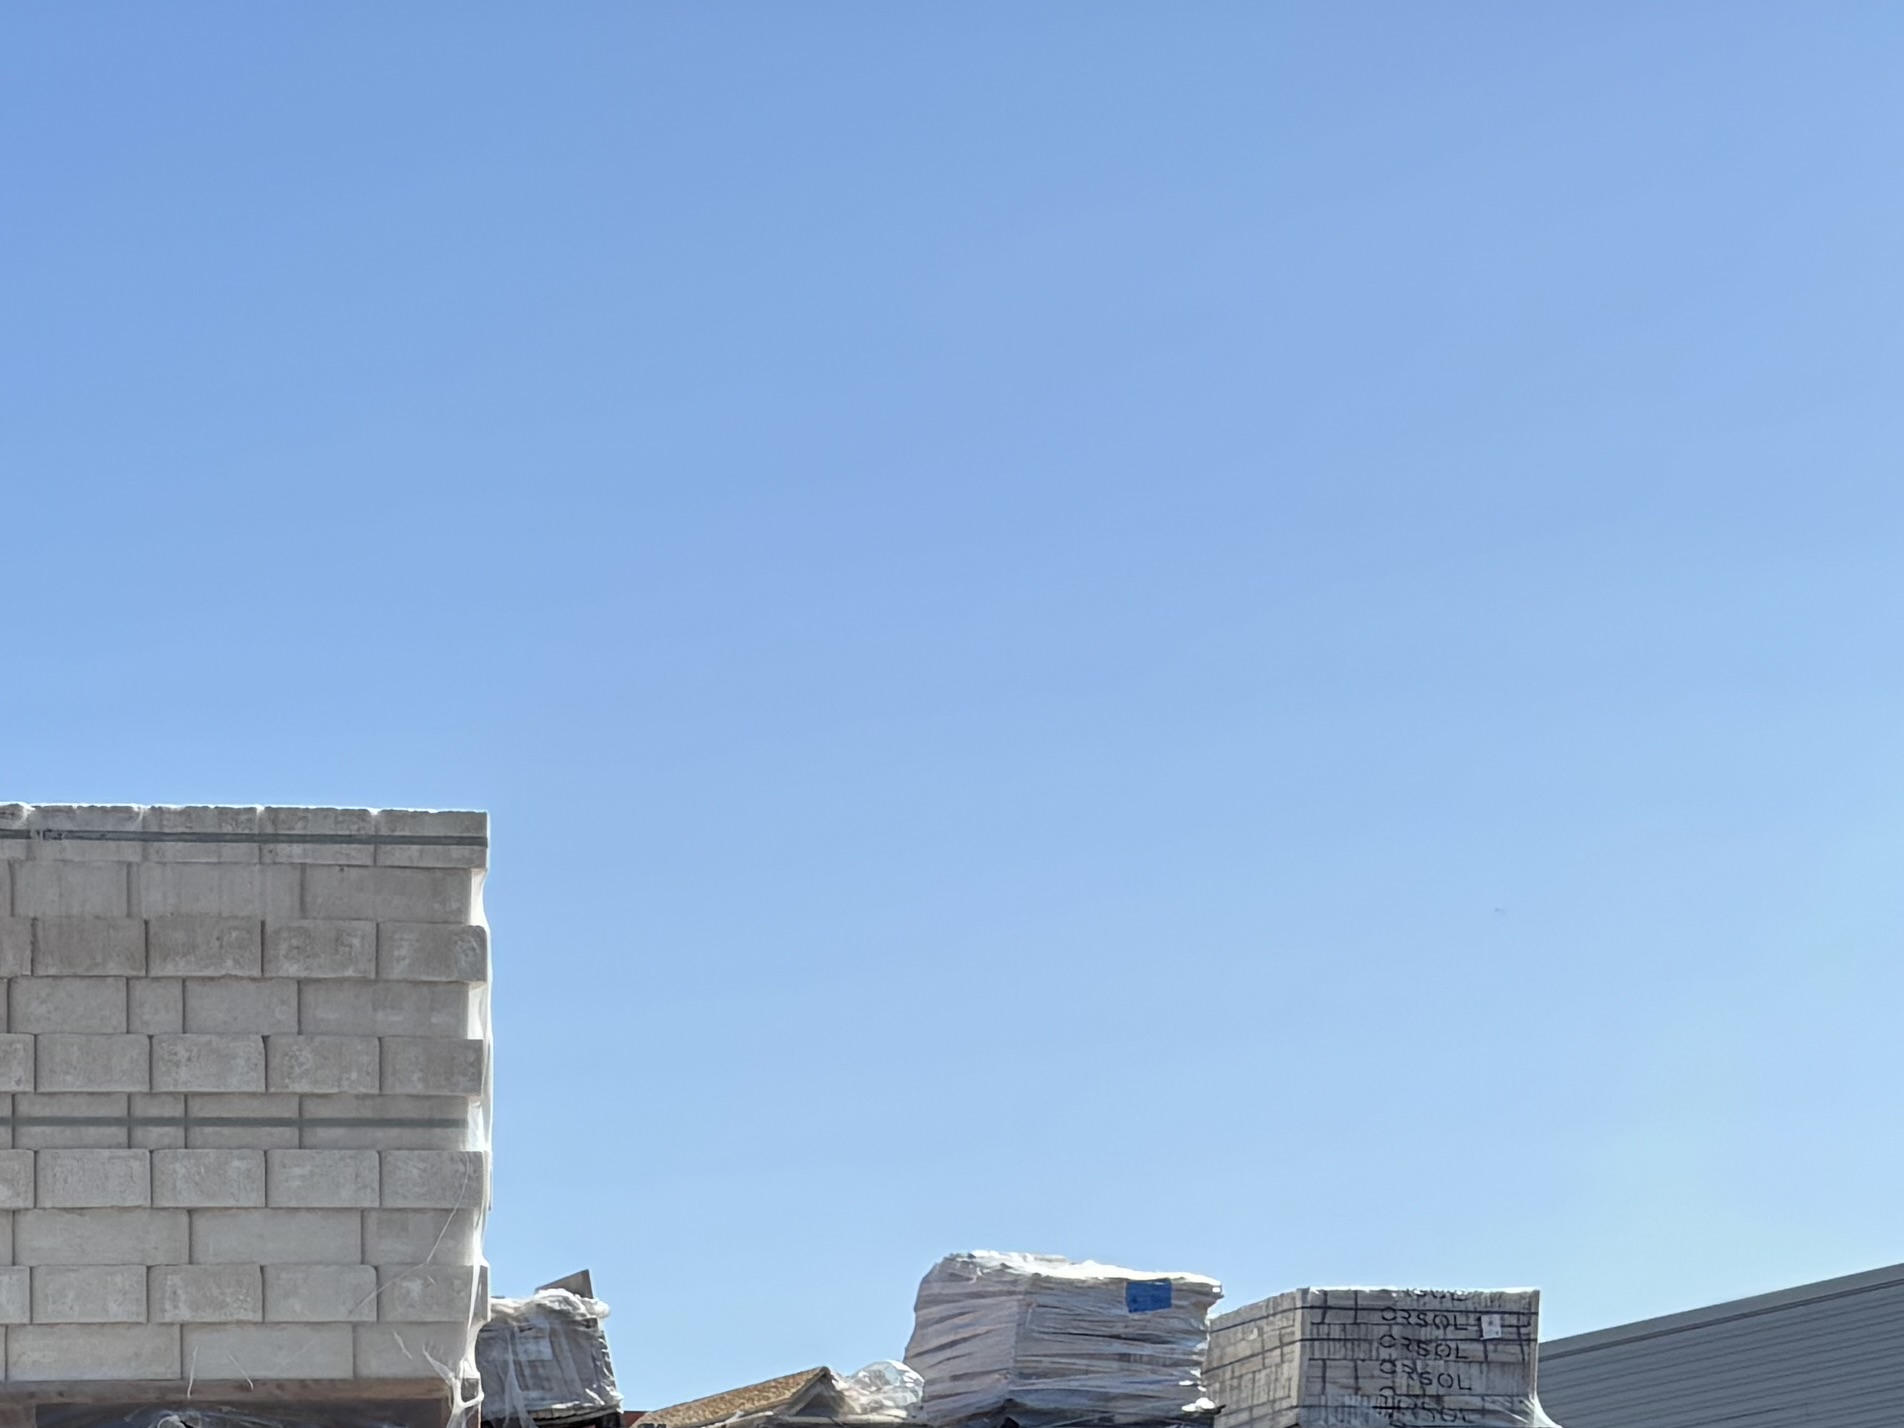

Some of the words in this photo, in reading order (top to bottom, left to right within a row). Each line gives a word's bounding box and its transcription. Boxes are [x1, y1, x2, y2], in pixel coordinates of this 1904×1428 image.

[1381, 1307, 1468, 1331] ORSOL
[1379, 1334, 1469, 1359] ORSOL
[1379, 1360, 1472, 1391] ORSOL
